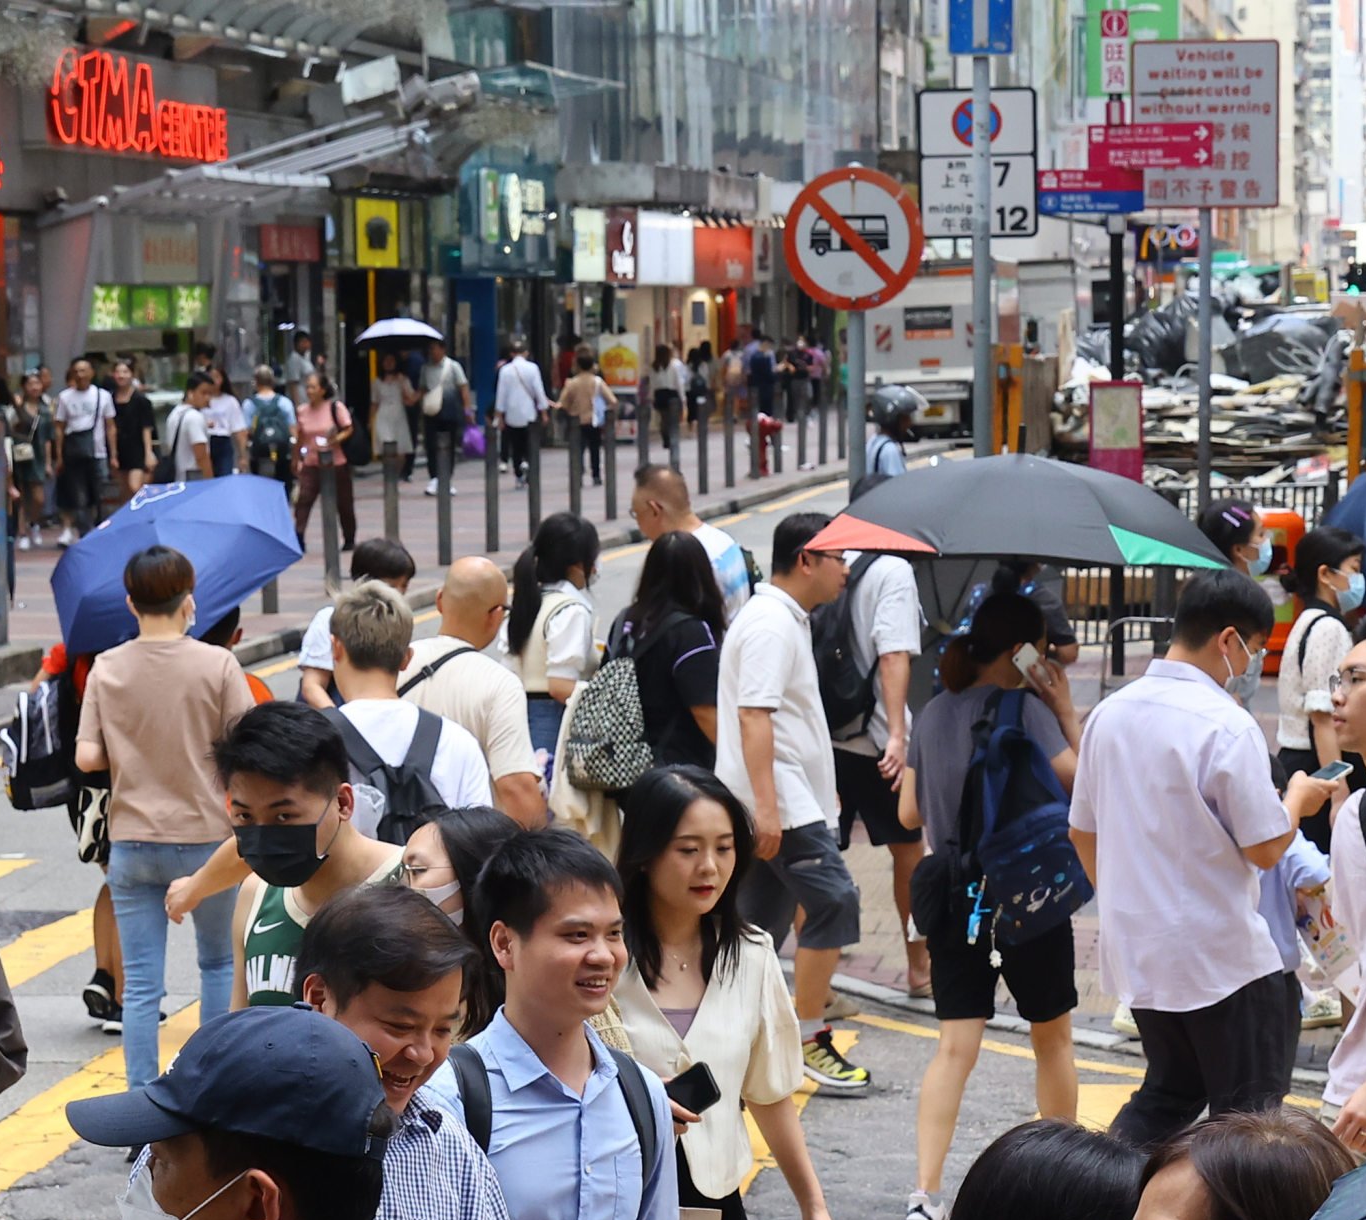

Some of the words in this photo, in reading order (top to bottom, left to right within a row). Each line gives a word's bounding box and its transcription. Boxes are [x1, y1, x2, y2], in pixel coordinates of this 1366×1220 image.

[1176, 49, 1234, 61] Vehicle
[1104, 44, 1125, 89] 旺角
[1148, 68, 1207, 80] waiting
[1212, 67, 1240, 79] will
[1244, 66, 1263, 79] be
[1139, 103, 1202, 115] without
[1207, 102, 1272, 115] warning
[947, 161, 967, 170] am
[941, 173, 974, 189] 上午
[993, 163, 1011, 187] 7
[928, 204, 973, 215] midnig
[995, 205, 1029, 232] 12
